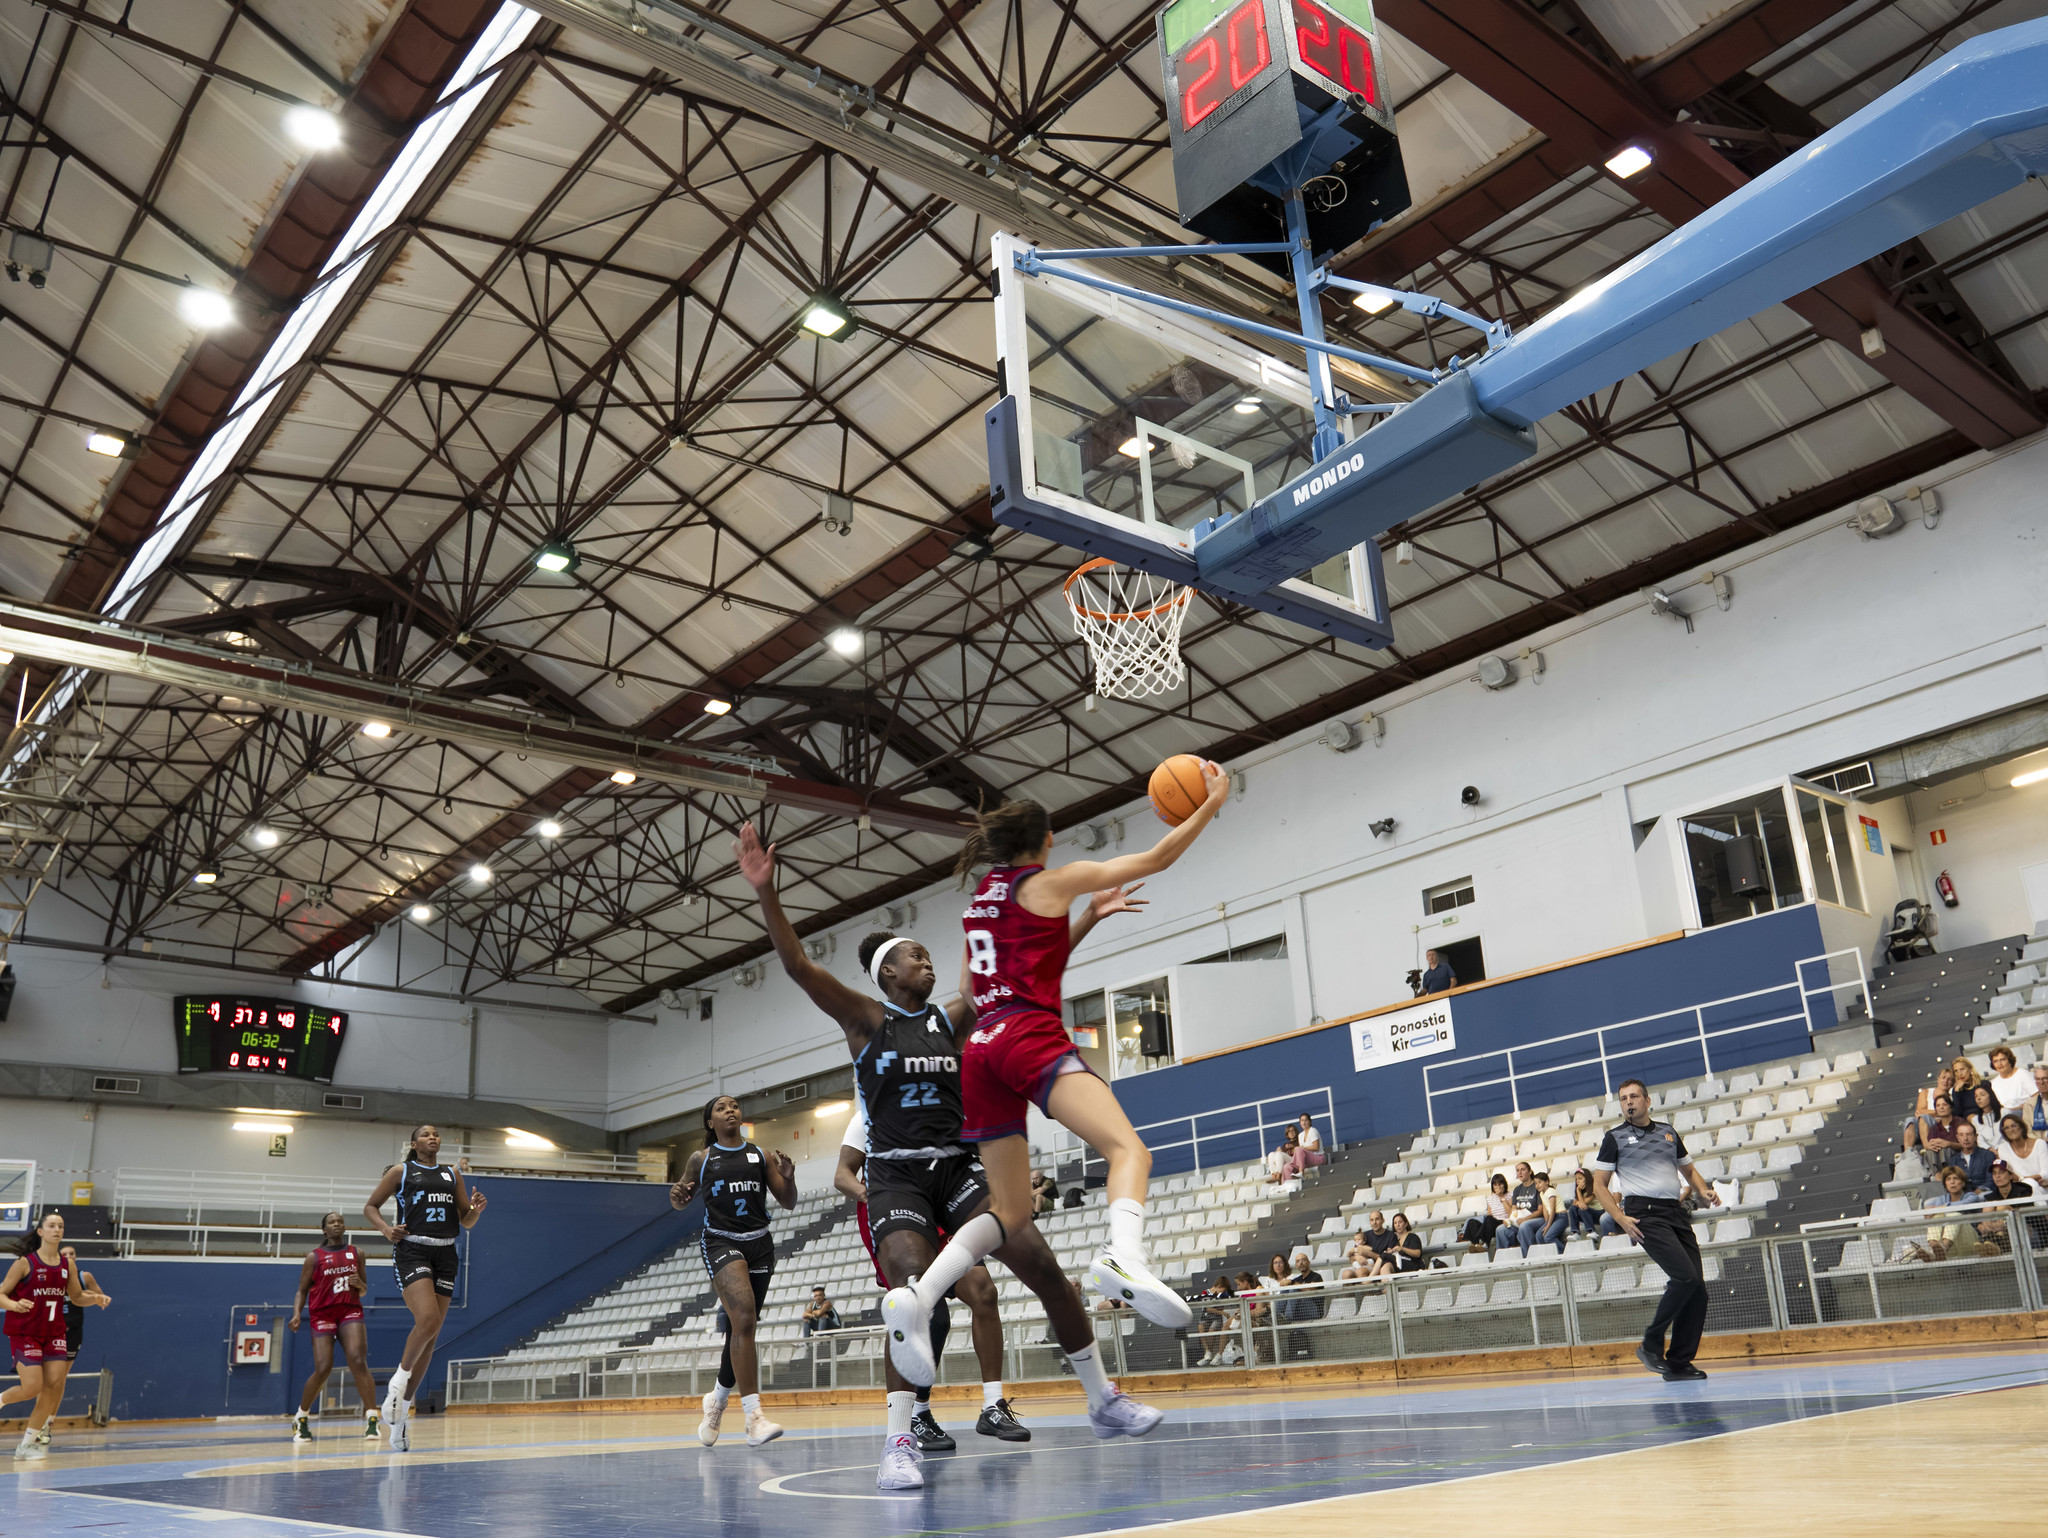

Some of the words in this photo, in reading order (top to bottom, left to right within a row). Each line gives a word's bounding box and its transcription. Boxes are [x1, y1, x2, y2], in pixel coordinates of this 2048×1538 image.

[1184, 0, 1270, 128] 20
[1296, 0, 1375, 104] 20
[1293, 453, 1365, 507] MONDO
[967, 929, 998, 977] 8
[234, 1007, 252, 1023] 37
[259, 1011, 267, 1024] 3
[277, 1013, 295, 1028] 48
[1390, 1012, 1446, 1036] Donostia
[241, 1032, 280, 1048] 06:32
[899, 1082, 941, 1108] 22
[425, 1207, 446, 1222] 23
[733, 1198, 749, 1217] 2
[45, 1301, 58, 1321] 7
